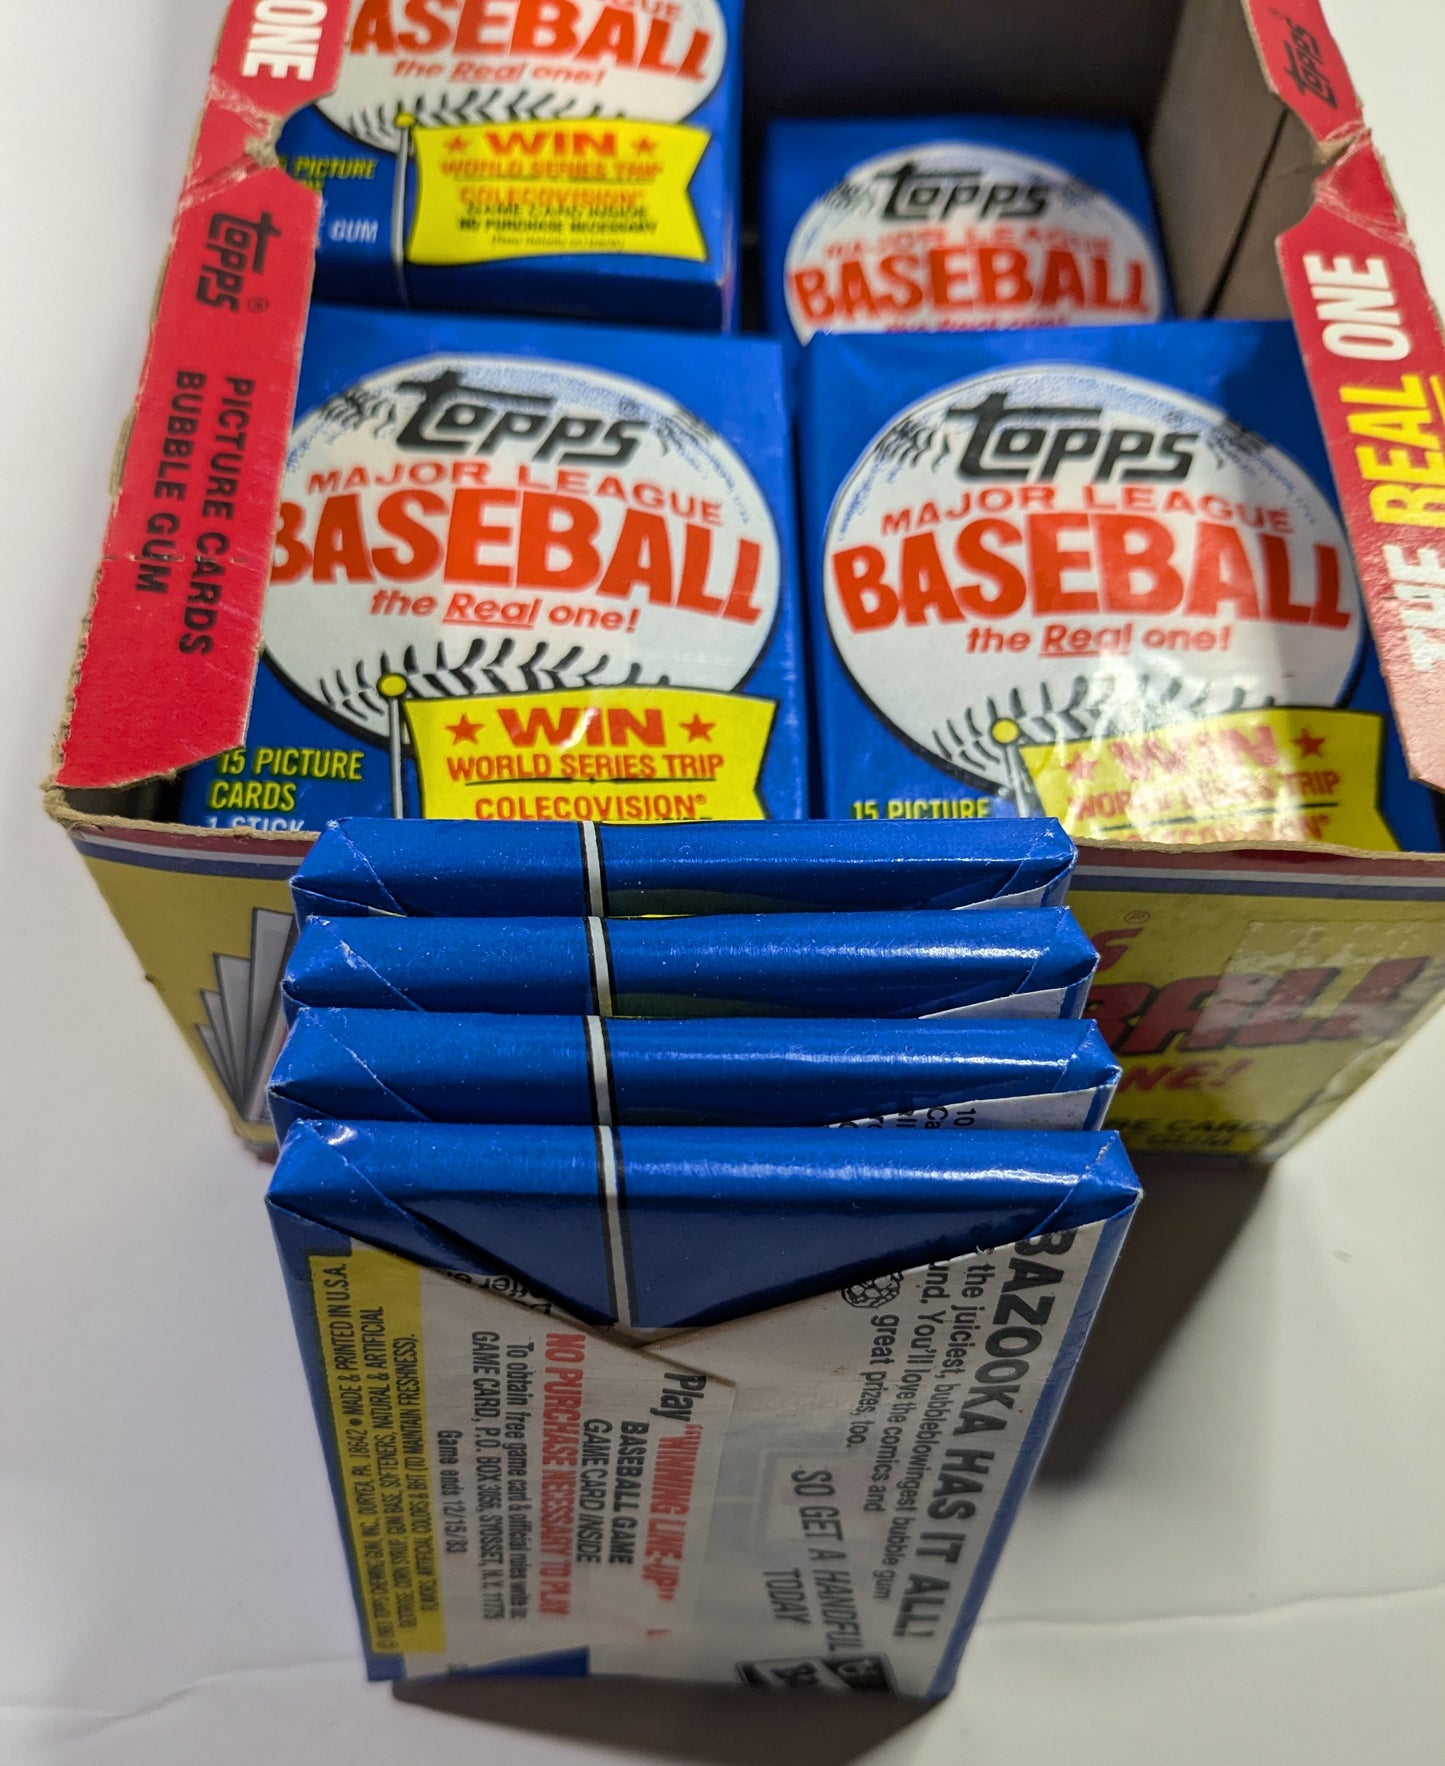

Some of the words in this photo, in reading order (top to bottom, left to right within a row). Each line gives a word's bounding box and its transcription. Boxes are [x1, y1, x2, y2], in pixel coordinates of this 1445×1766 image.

[242, 0, 328, 82] ONE
[349, 0, 714, 82] ASEBALL
[393, 59, 445, 80] the
[448, 61, 529, 84] Real
[485, 131, 617, 157] WIN
[293, 155, 378, 180] PICTURE
[329, 218, 379, 245] GUM
[791, 246, 1150, 321] BASEBALL
[1303, 254, 1412, 362] ONE
[153, 369, 207, 502] BUBBLE
[202, 376, 255, 521] PICTURE
[1339, 375, 1445, 528] REAL
[308, 461, 492, 495] MAJOR
[517, 465, 725, 527] LEAGUE
[881, 484, 1055, 536] MAJOR
[1083, 484, 1294, 535] LEAGUE
[135, 512, 181, 595] GUM
[270, 488, 763, 627] BASEBALL
[831, 512, 1353, 636] BASEBALL
[178, 531, 230, 656] CARDS
[369, 588, 437, 617] the
[443, 590, 541, 630] Real
[549, 605, 642, 634] one!
[965, 626, 1031, 655] the
[1039, 623, 1134, 659] Real
[1142, 626, 1231, 652] one!
[497, 707, 665, 749] WIN
[218, 748, 247, 775] 15
[253, 747, 366, 782] PICTURE
[446, 754, 551, 782] WORLD
[560, 755, 659, 780] SERIES
[665, 754, 725, 780] TRIP
[209, 781, 297, 812] CARDS
[853, 801, 878, 819] 15
[890, 800, 990, 819] PICTURE
[1116, 1057, 1254, 1092] NE!
[323, 1263, 351, 1301] U.S.A.
[961, 1262, 996, 1299] the
[327, 1304, 353, 1318] IN
[952, 1228, 1076, 1437] BAZOOKA
[329, 1320, 359, 1371] PRINTED
[359, 1306, 388, 1370] ARTIFICIAL
[472, 1330, 501, 1374] GAME
[506, 1342, 535, 1359] To
[545, 1332, 586, 1364] NO
[870, 1313, 900, 1366] great
[906, 1310, 947, 1365] You'll
[934, 1304, 986, 1380] juiciest,
[339, 1384, 365, 1416] MADE
[368, 1383, 394, 1429] NATURAL
[470, 1377, 501, 1423] CARD,
[506, 1362, 535, 1406] obtain
[650, 1372, 706, 1422] Play
[848, 1370, 889, 1417] prizes,
[895, 1368, 931, 1400] love
[400, 1408, 425, 1454] MAINTAIN
[504, 1411, 532, 1439] free
[542, 1366, 584, 1466] PURCHASE
[846, 1419, 875, 1448] too.
[887, 1400, 917, 1424] the
[437, 1429, 464, 1465] Game
[473, 1426, 502, 1453] P.O.
[502, 1442, 528, 1476] game
[582, 1418, 613, 1467] GAME
[870, 1424, 903, 1482] comics
[895, 1382, 962, 1512] bubbleblowingest
[440, 1468, 465, 1497] ends
[475, 1455, 502, 1482] BOX
[613, 1420, 650, 1513] BASEBALL
[790, 1469, 836, 1498] SO
[928, 1447, 996, 1520] HAS
[507, 1478, 533, 1502] card
[579, 1468, 609, 1511] CARD
[863, 1484, 887, 1513] and
[508, 1513, 533, 1551] official
[539, 1469, 578, 1556] NECESSARY
[799, 1505, 844, 1542] GET
[576, 1512, 605, 1564] INSIDE
[608, 1515, 639, 1566] GAME
[807, 1547, 848, 1561] A
[881, 1516, 916, 1567] bubble
[915, 1531, 967, 1564] IT
[509, 1553, 533, 1580] rules
[539, 1559, 573, 1578] TO
[872, 1568, 897, 1600] gum
[538, 1580, 572, 1616] PLAY
[763, 1566, 812, 1626] TODAY
[812, 1567, 865, 1652] HANDFUL
